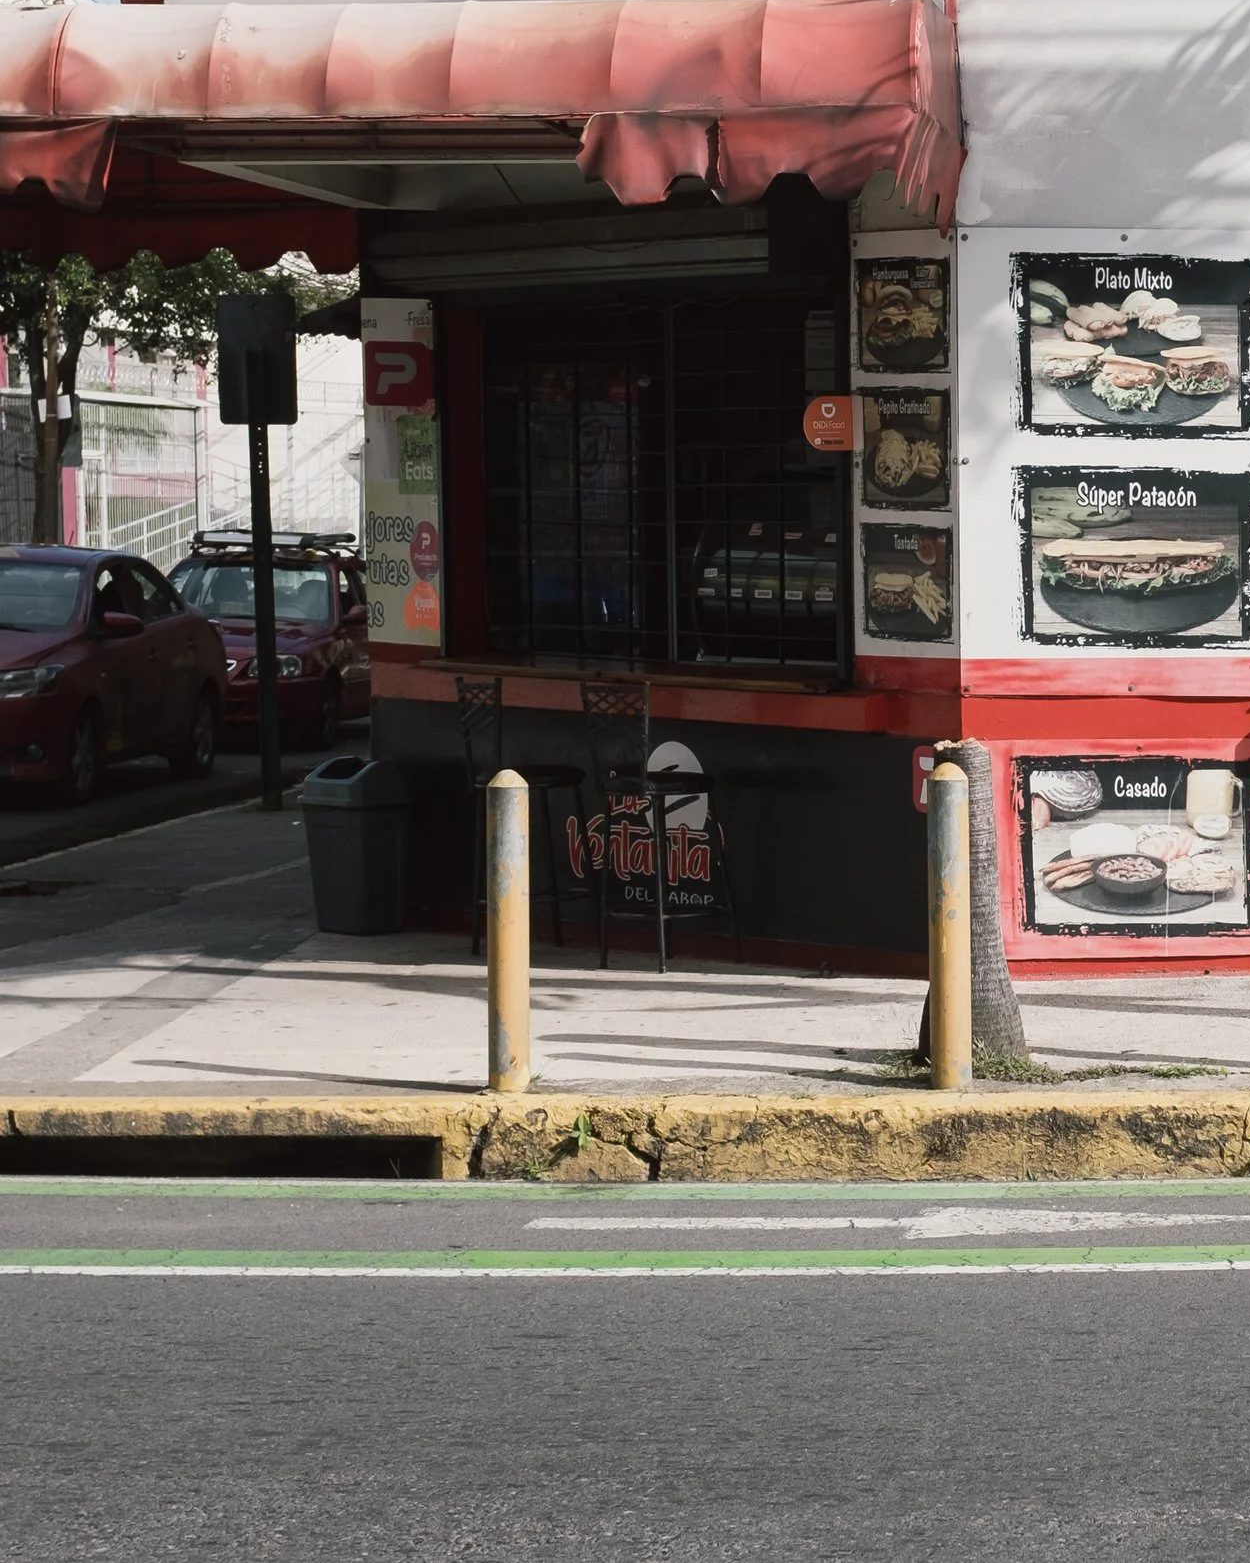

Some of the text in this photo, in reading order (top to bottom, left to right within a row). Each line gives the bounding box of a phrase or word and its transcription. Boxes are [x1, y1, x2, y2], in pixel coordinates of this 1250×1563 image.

[1095, 266, 1173, 291] Plato Mixto
[405, 460, 434, 480] Eats
[1077, 481, 1198, 515] Súper Patacón
[1113, 775, 1168, 799] Casado
[624, 885, 654, 903] DEL
